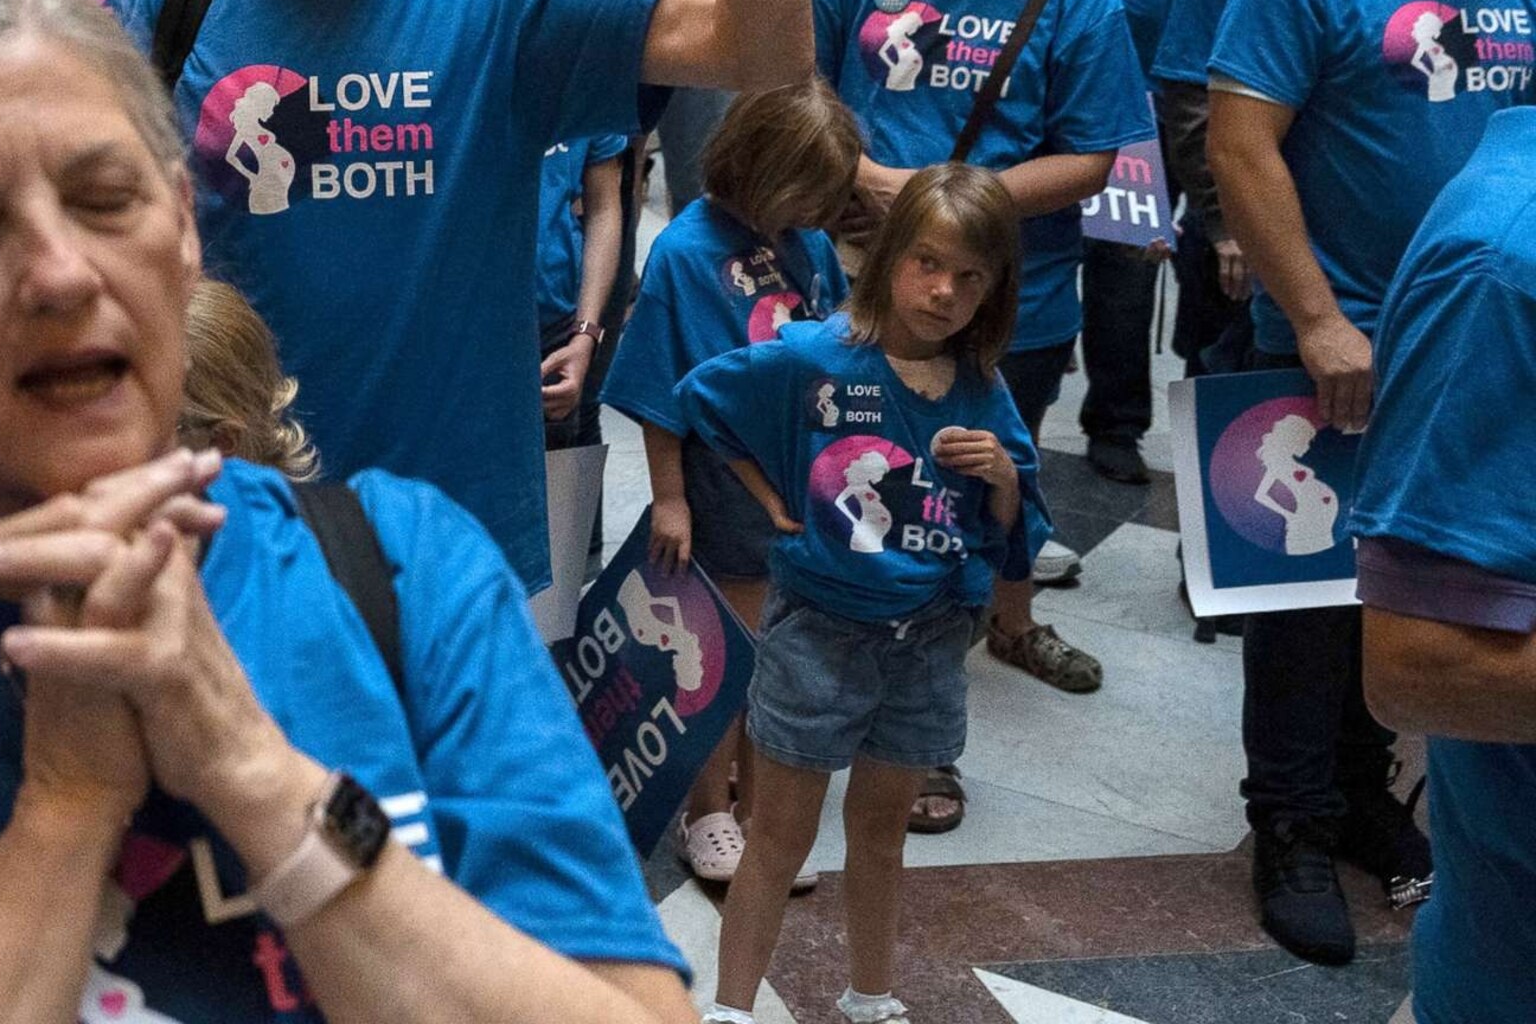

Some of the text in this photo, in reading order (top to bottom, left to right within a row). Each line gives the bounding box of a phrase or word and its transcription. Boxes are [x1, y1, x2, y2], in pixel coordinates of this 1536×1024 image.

[938, 13, 1017, 45] LOVE
[1461, 8, 1532, 35] LOVE
[1474, 36, 1535, 61] them
[309, 71, 433, 111] LOVE
[1466, 65, 1533, 92] BOTH
[326, 118, 434, 153] them
[311, 160, 435, 199] BOTH
[1081, 185, 1160, 228] TH
[847, 385, 882, 397] LOVE
[845, 412, 882, 423] BOTH
[901, 524, 968, 556] BO
[566, 608, 626, 705] BOT
[608, 696, 687, 812] LOVE
